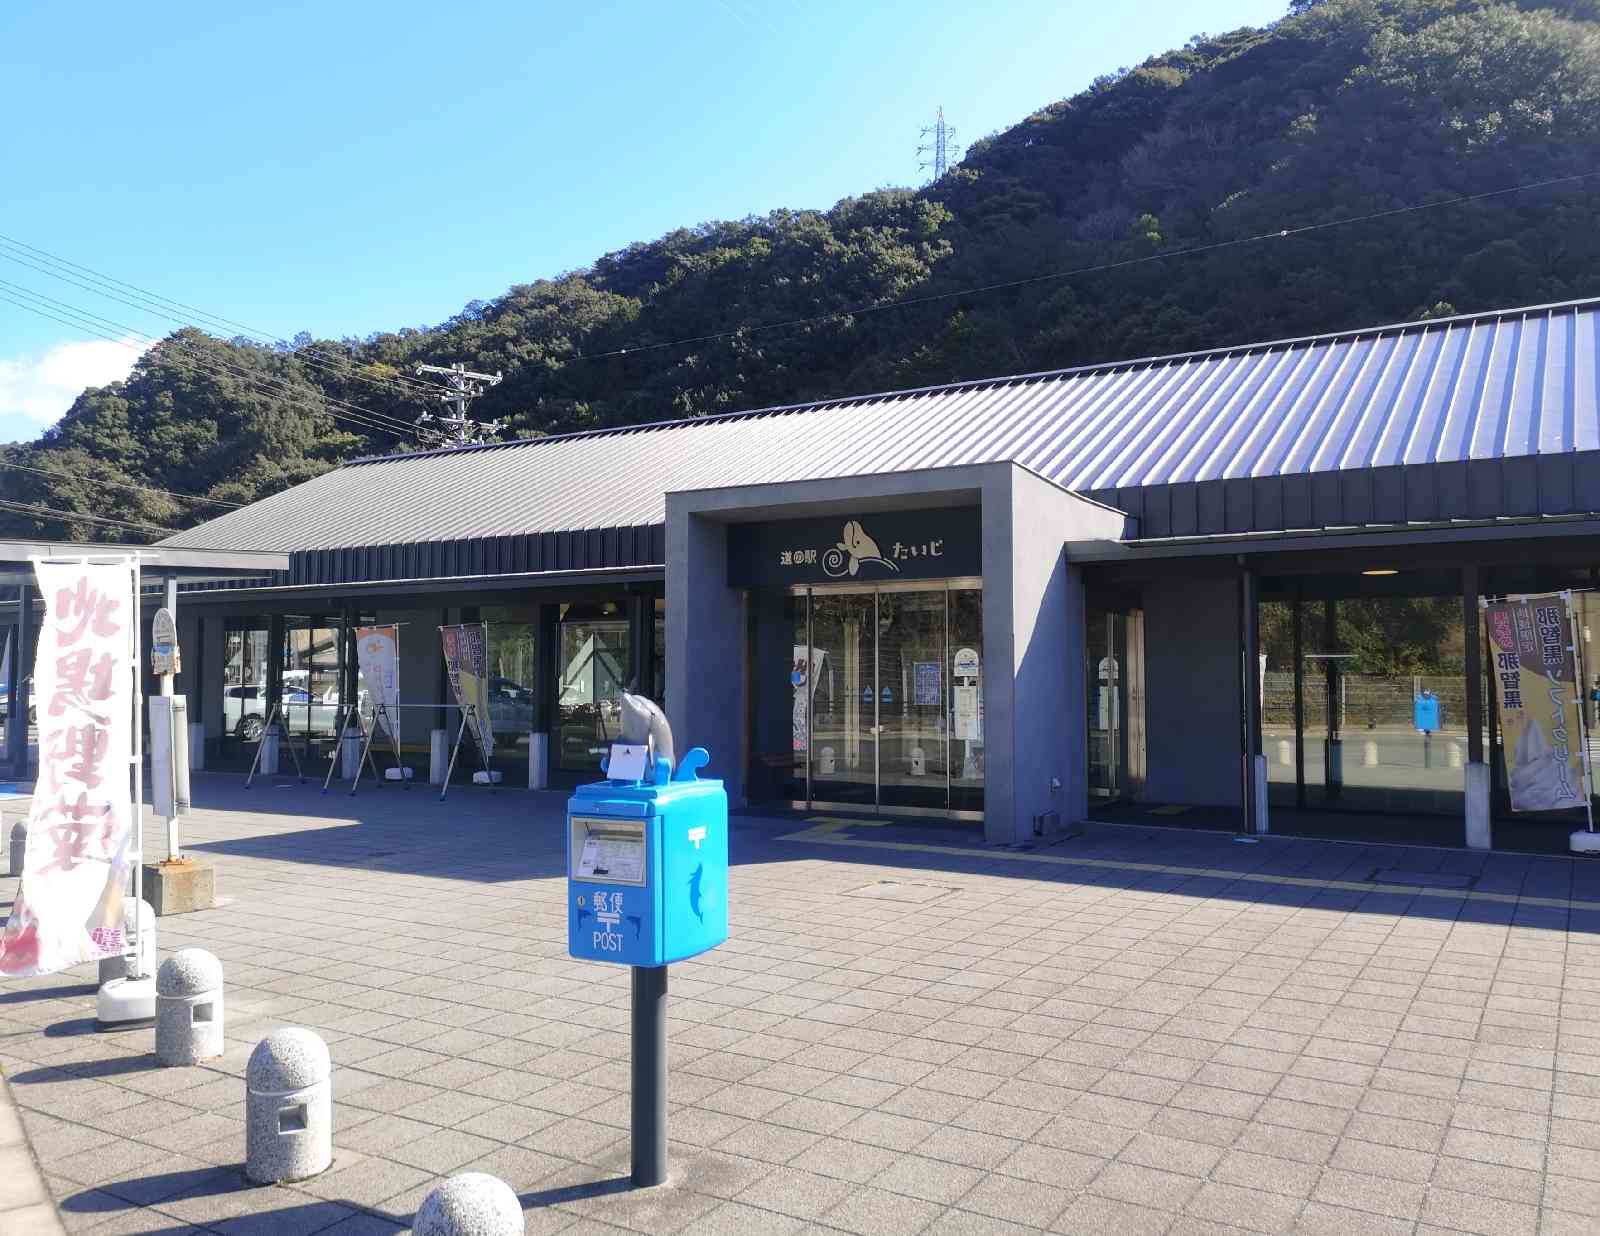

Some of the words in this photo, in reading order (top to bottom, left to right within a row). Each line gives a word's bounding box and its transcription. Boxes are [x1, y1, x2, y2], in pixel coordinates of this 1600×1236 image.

[780, 549, 817, 566] 道の駅
[892, 539, 943, 560] たいじ
[593, 891, 623, 913] 郵便
[593, 931, 623, 953] POST
